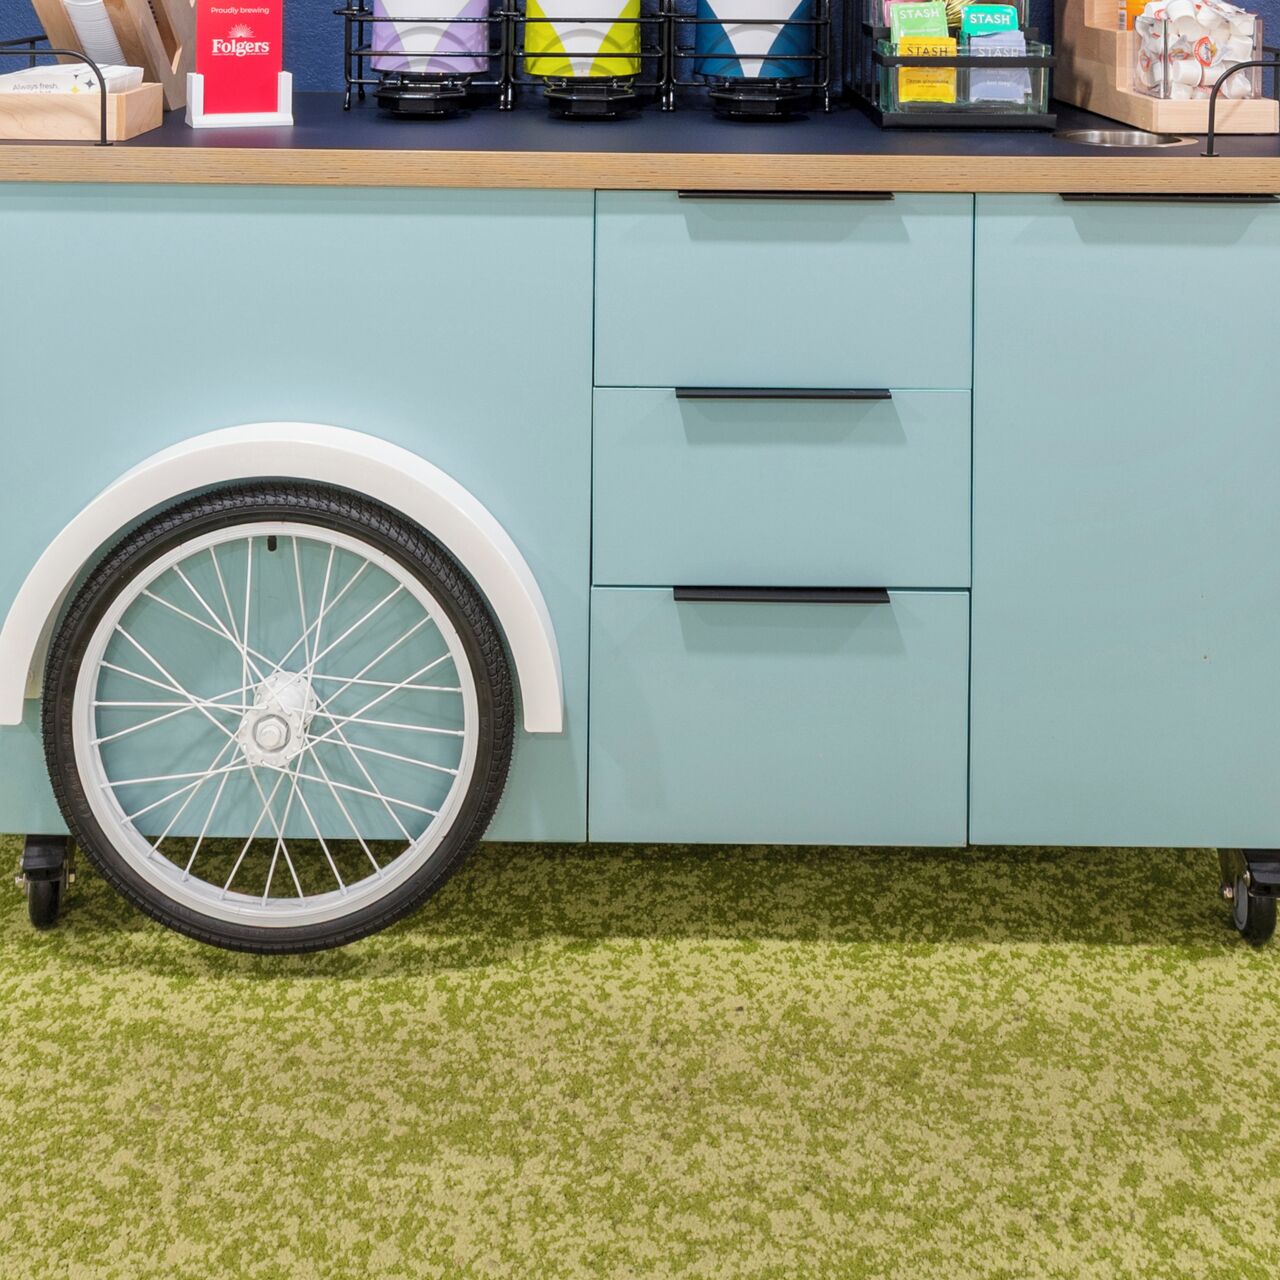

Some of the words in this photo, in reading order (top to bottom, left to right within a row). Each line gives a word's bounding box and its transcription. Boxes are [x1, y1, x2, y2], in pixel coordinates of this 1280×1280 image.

[210, 7, 239, 15] Proudly
[240, 7, 270, 15] brewing
[900, 9, 940, 19] STASH
[970, 14, 1010, 25] STASH
[212, 39, 270, 57] Folgers
[907, 47, 948, 56] STASH
[978, 48, 1019, 57] STASH
[13, 83, 38, 91] Always
